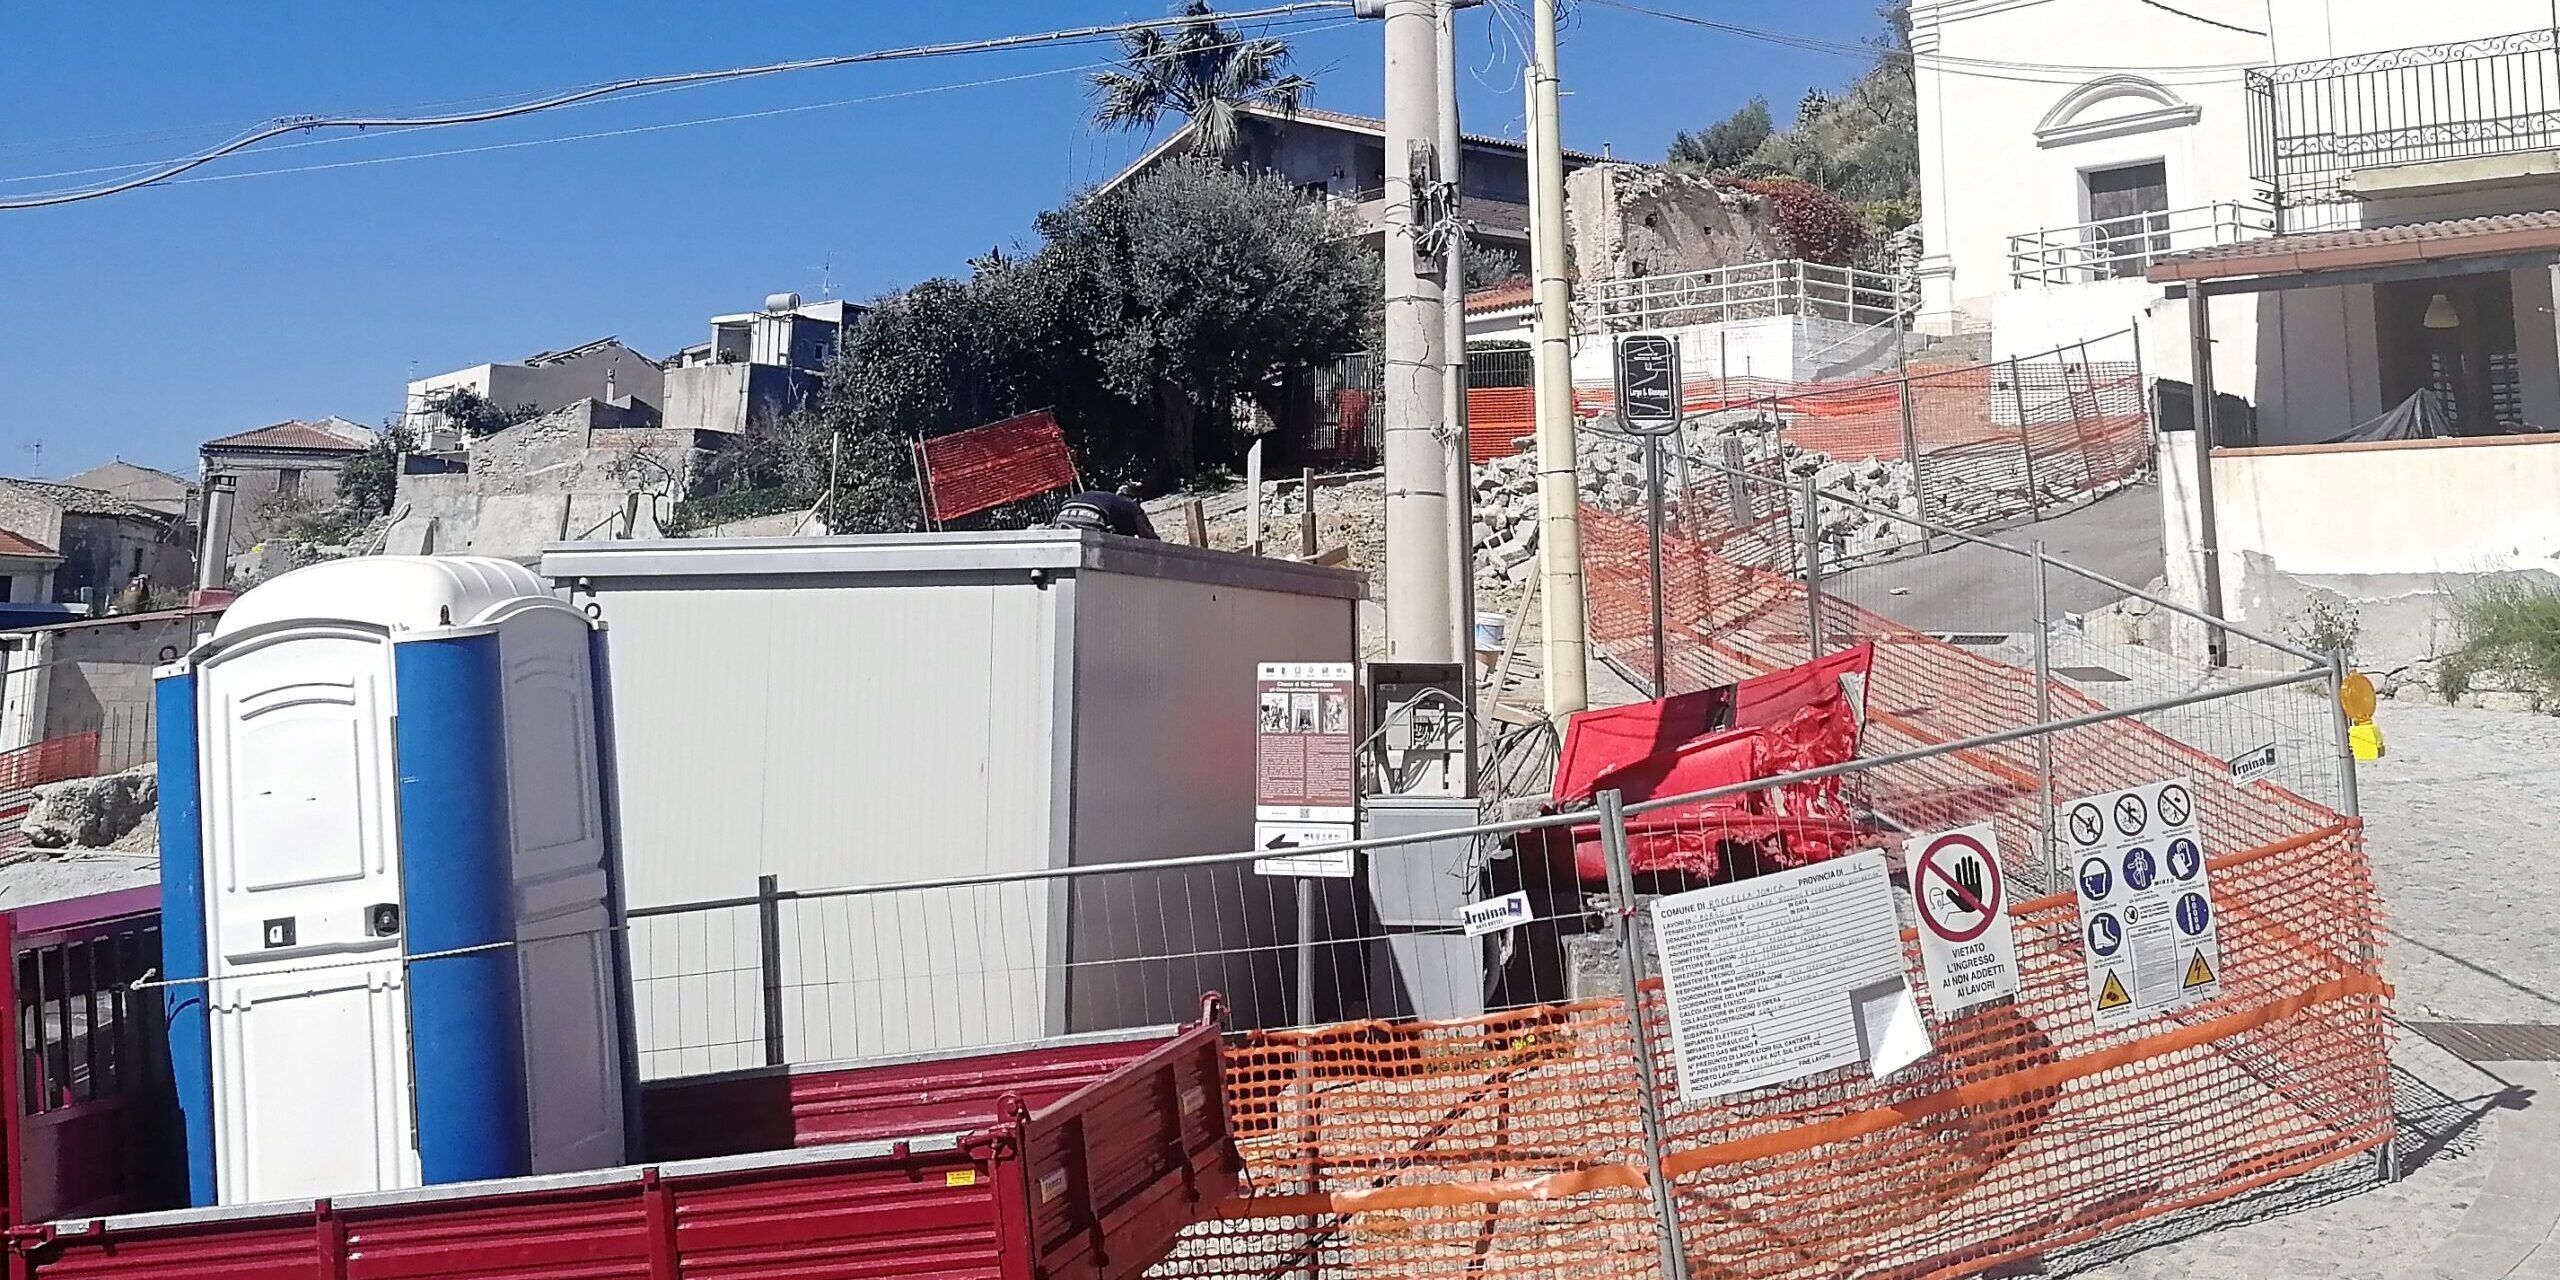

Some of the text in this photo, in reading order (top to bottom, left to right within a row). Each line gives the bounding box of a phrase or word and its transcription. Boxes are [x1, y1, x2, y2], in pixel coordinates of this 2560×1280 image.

[1797, 868, 1843, 886] PROVINCIA DI
[1660, 901, 1705, 919] COMUNE DI
[1663, 919, 1684, 929] LAVORI
[1952, 943, 1985, 959] VIETATO
[1947, 954, 1995, 974] L'INGRESSO
[1943, 964, 2005, 989] AI NON ADDETTI
[1957, 988, 1965, 998] AI
[1966, 981, 1995, 997] LAVORI
